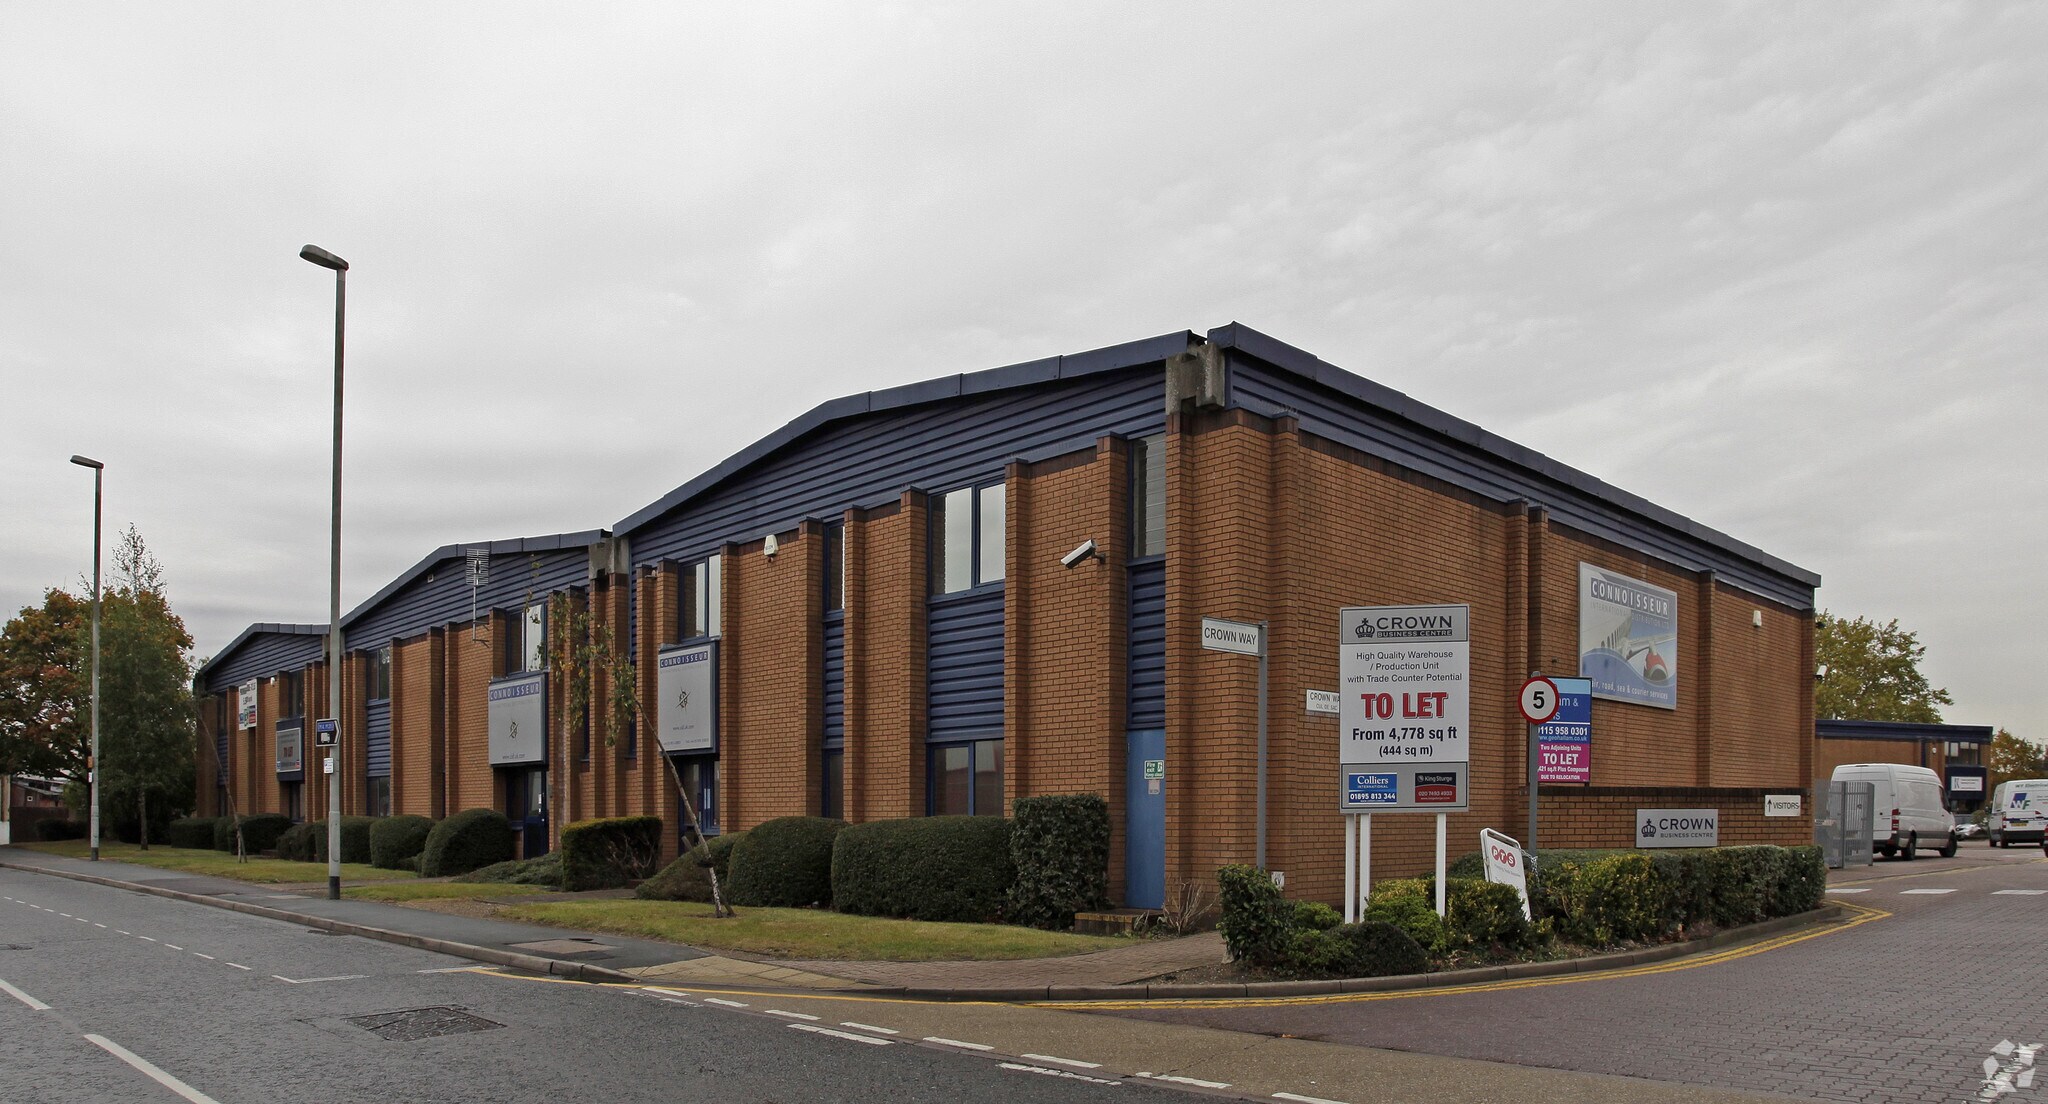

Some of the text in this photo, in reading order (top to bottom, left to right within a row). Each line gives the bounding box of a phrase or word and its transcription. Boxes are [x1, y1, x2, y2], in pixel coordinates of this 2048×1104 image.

[1592, 581, 1668, 615] CONNOISSEUR
[1376, 615, 1452, 630] CROWN
[1205, 627, 1256, 645] CROWN WAY
[1377, 629, 1452, 638] BUSINESS CENTRE
[660, 652, 708, 667] CONNOISSEUR
[1356, 650, 1453, 661] High Quality Warehouse
[1369, 662, 1439, 671] / Production Unit
[1347, 673, 1462, 683] with Trade Counter Potential
[490, 683, 539, 700] CONNOISSEUR
[1310, 692, 1340, 702] CROWN WA
[1361, 692, 1449, 720] TO LET
[1533, 691, 1545, 709] 5
[1573, 698, 1579, 706] &
[1352, 726, 1457, 742] From 4,778 sq ft
[1555, 726, 1568, 735] 958
[1571, 727, 1587, 736] 0301
[1379, 745, 1433, 757] (444 sq m)
[1543, 753, 1578, 765] TO LET
[1357, 776, 1389, 784] Colliers
[1659, 818, 1714, 830] CROWN
[1492, 848, 1515, 865] PTS
